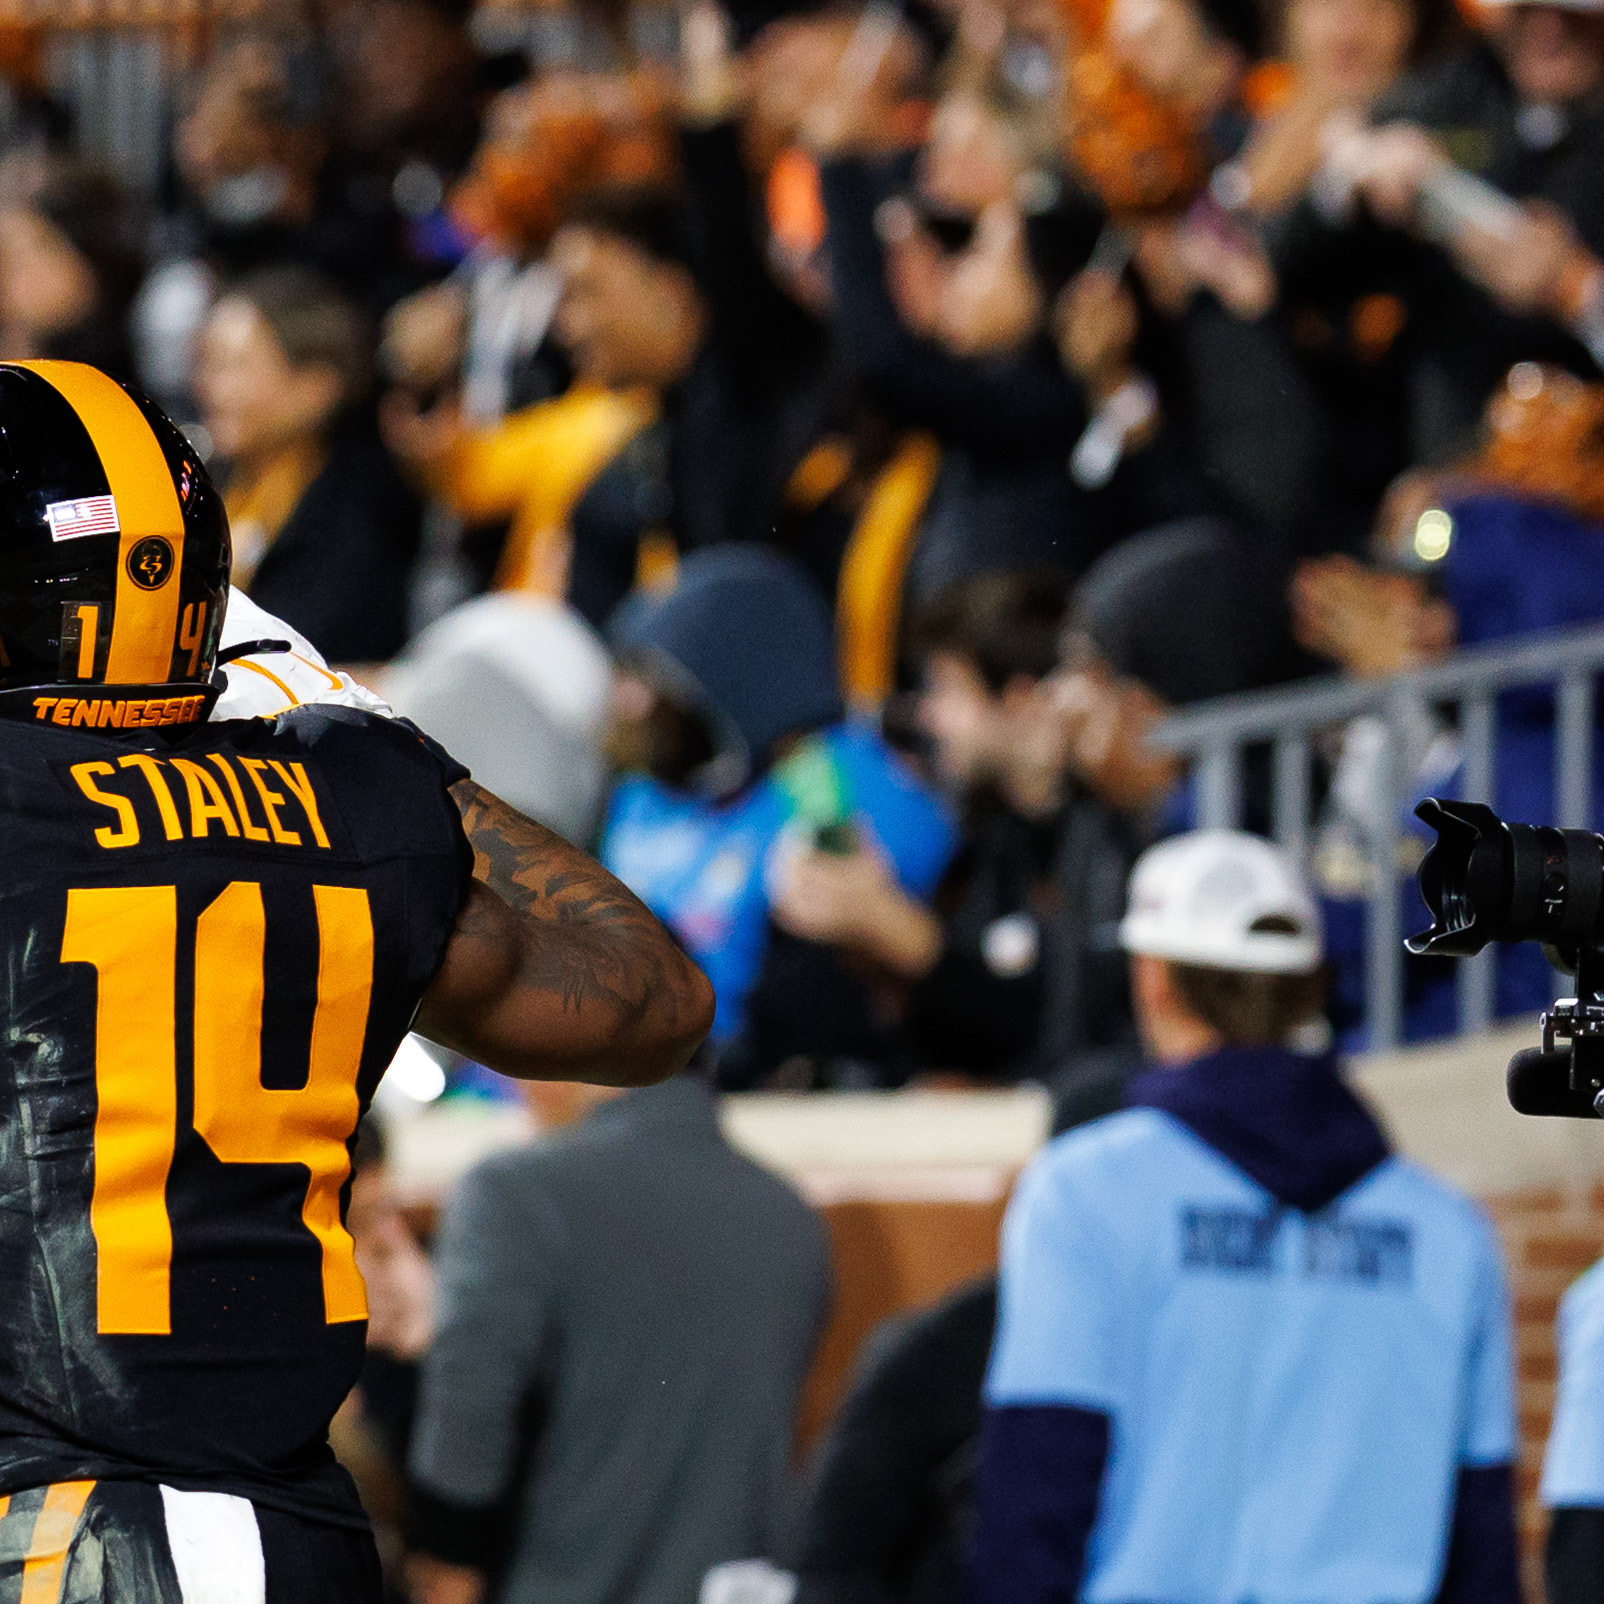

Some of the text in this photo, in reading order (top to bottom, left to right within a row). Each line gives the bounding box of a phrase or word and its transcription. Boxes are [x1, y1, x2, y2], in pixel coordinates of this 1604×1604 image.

[32, 694, 206, 729] TENNESSEE
[69, 752, 331, 849] STALEY
[59, 881, 374, 1336] 14
